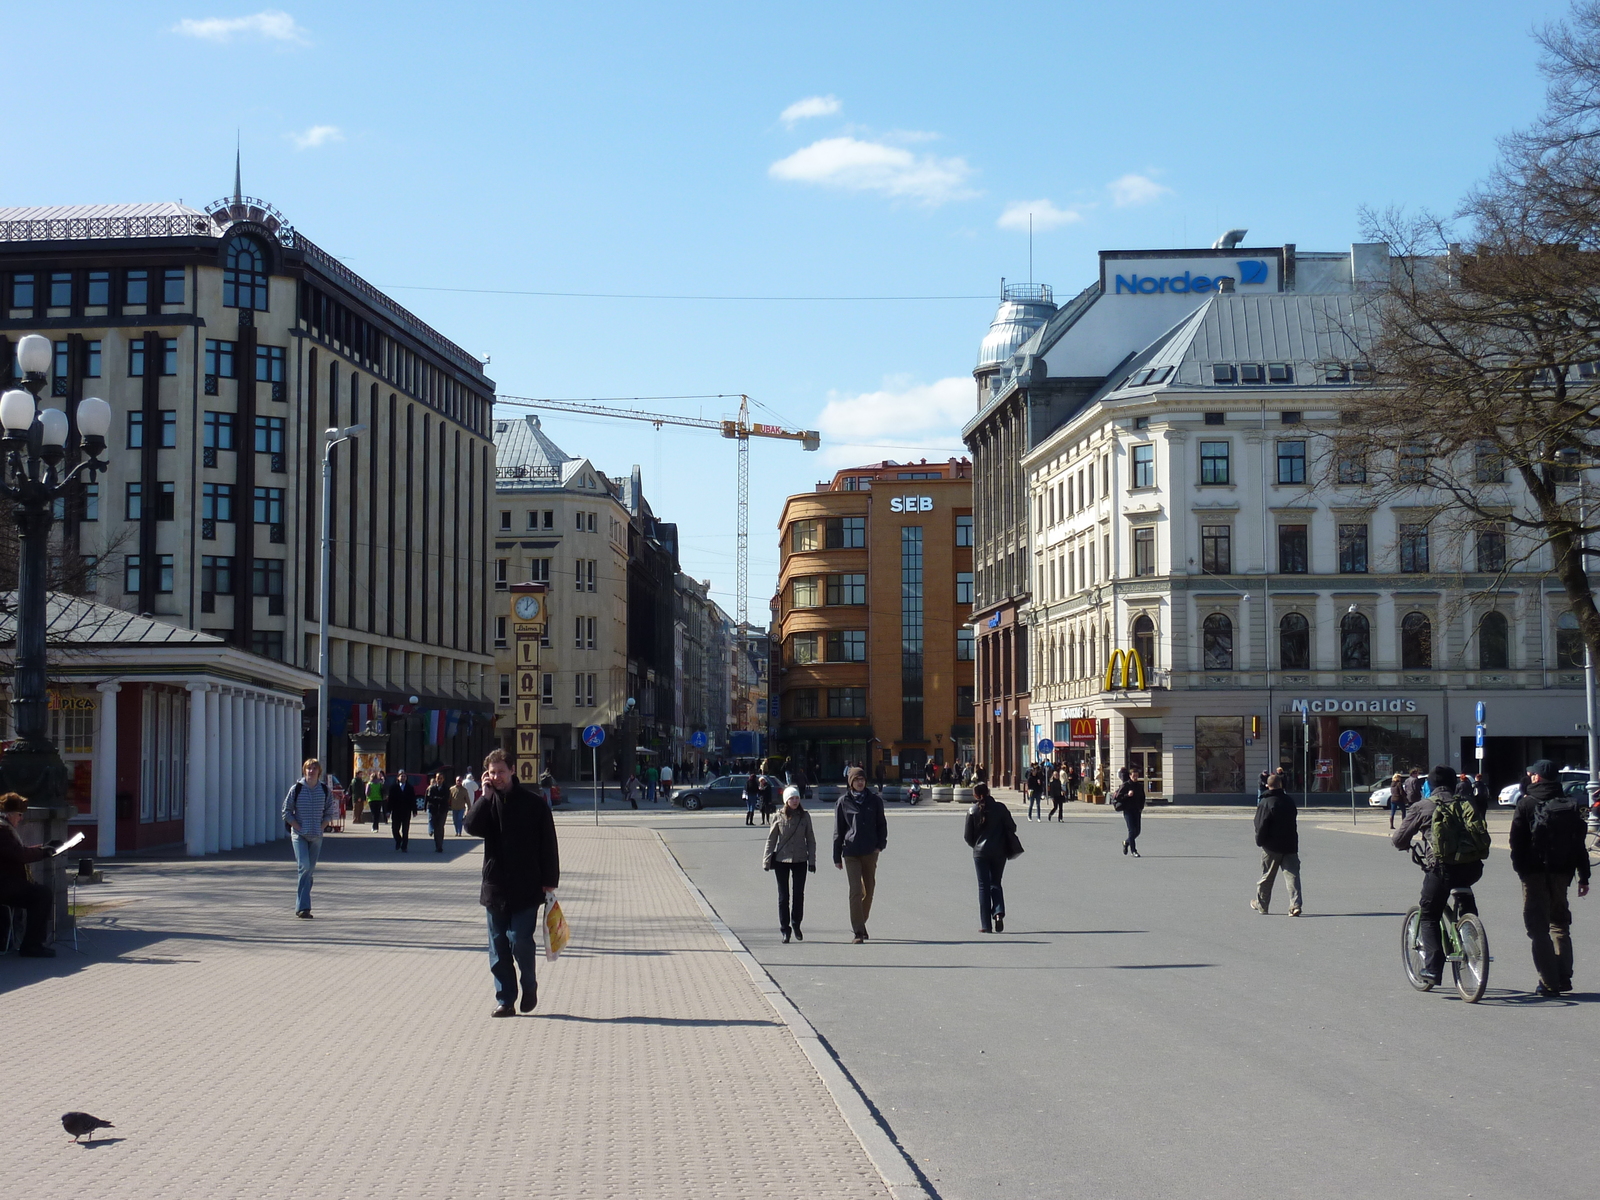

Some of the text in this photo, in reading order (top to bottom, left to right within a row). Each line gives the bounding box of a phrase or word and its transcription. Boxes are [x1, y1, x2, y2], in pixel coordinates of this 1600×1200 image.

[204, 196, 290, 226] RESORĀNS
[213, 205, 280, 233] OTTO
[229, 224, 275, 243] SCHWARZ
[61, 698, 94, 710] PICA
[1291, 698, 1417, 713] McDonald's
